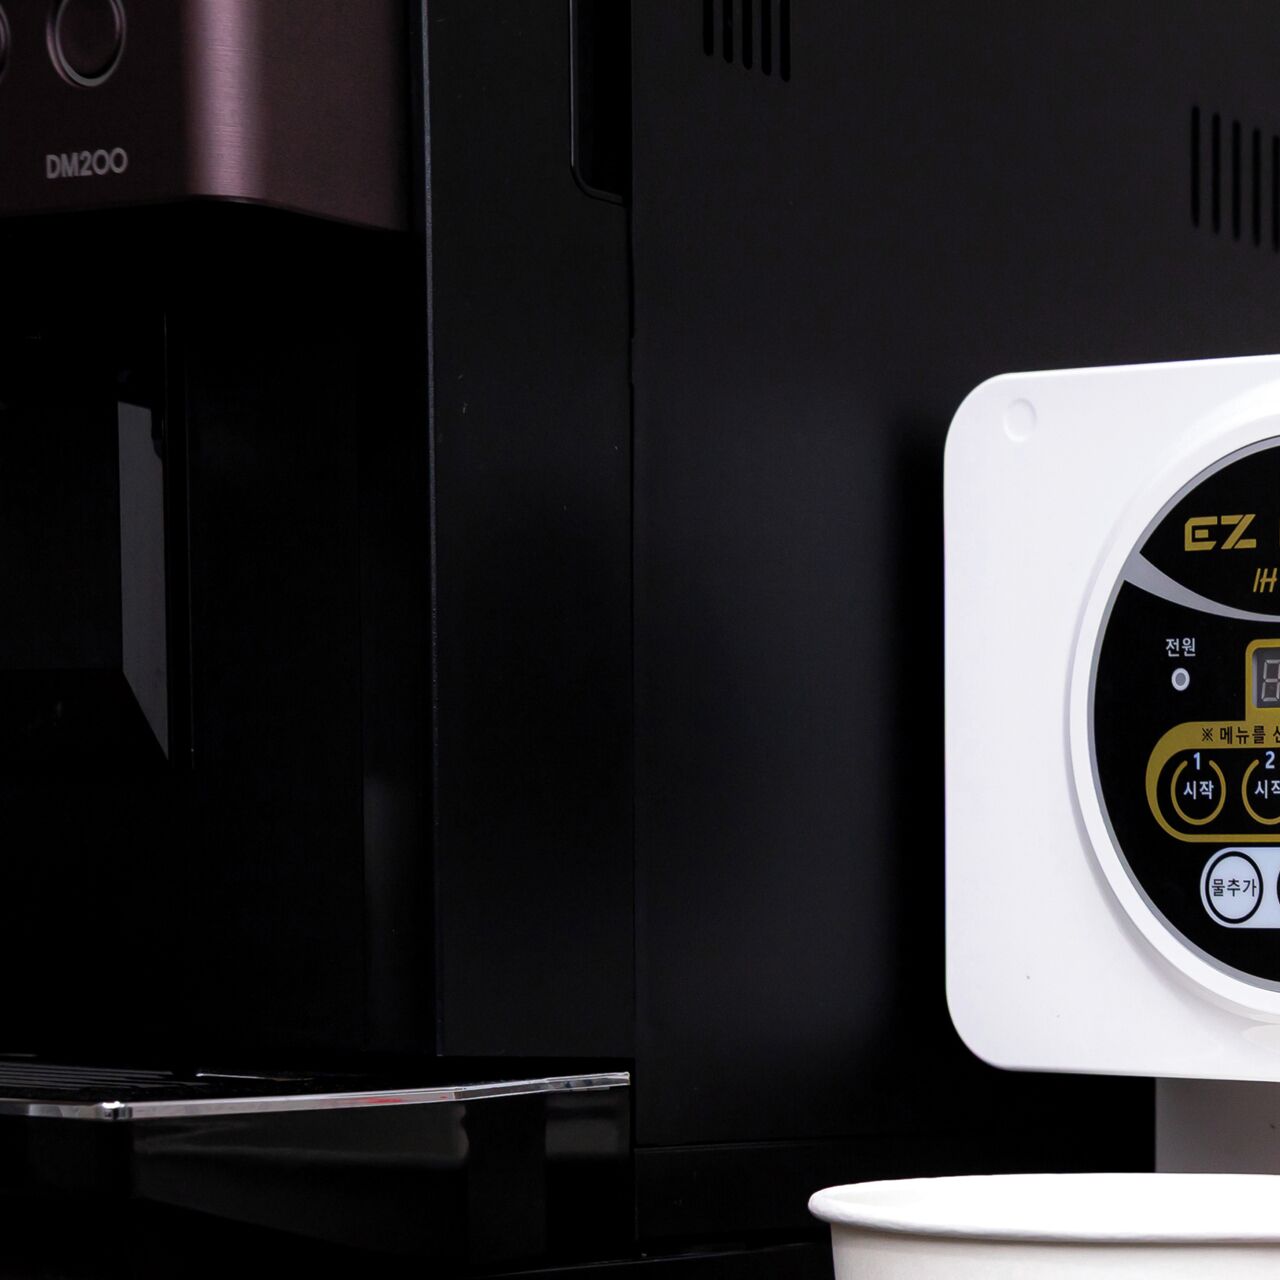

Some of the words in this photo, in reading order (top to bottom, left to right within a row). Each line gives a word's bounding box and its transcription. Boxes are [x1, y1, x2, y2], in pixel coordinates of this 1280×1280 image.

[46, 147, 128, 180] DM200
[1184, 513, 1257, 552] EZ
[1165, 637, 1197, 658] 전원
[1219, 723, 1267, 745] 메뉴를
[1193, 751, 1201, 770] 1
[1265, 750, 1276, 769] 2
[1183, 780, 1215, 800] 시작
[1211, 878, 1257, 897] 물추가
